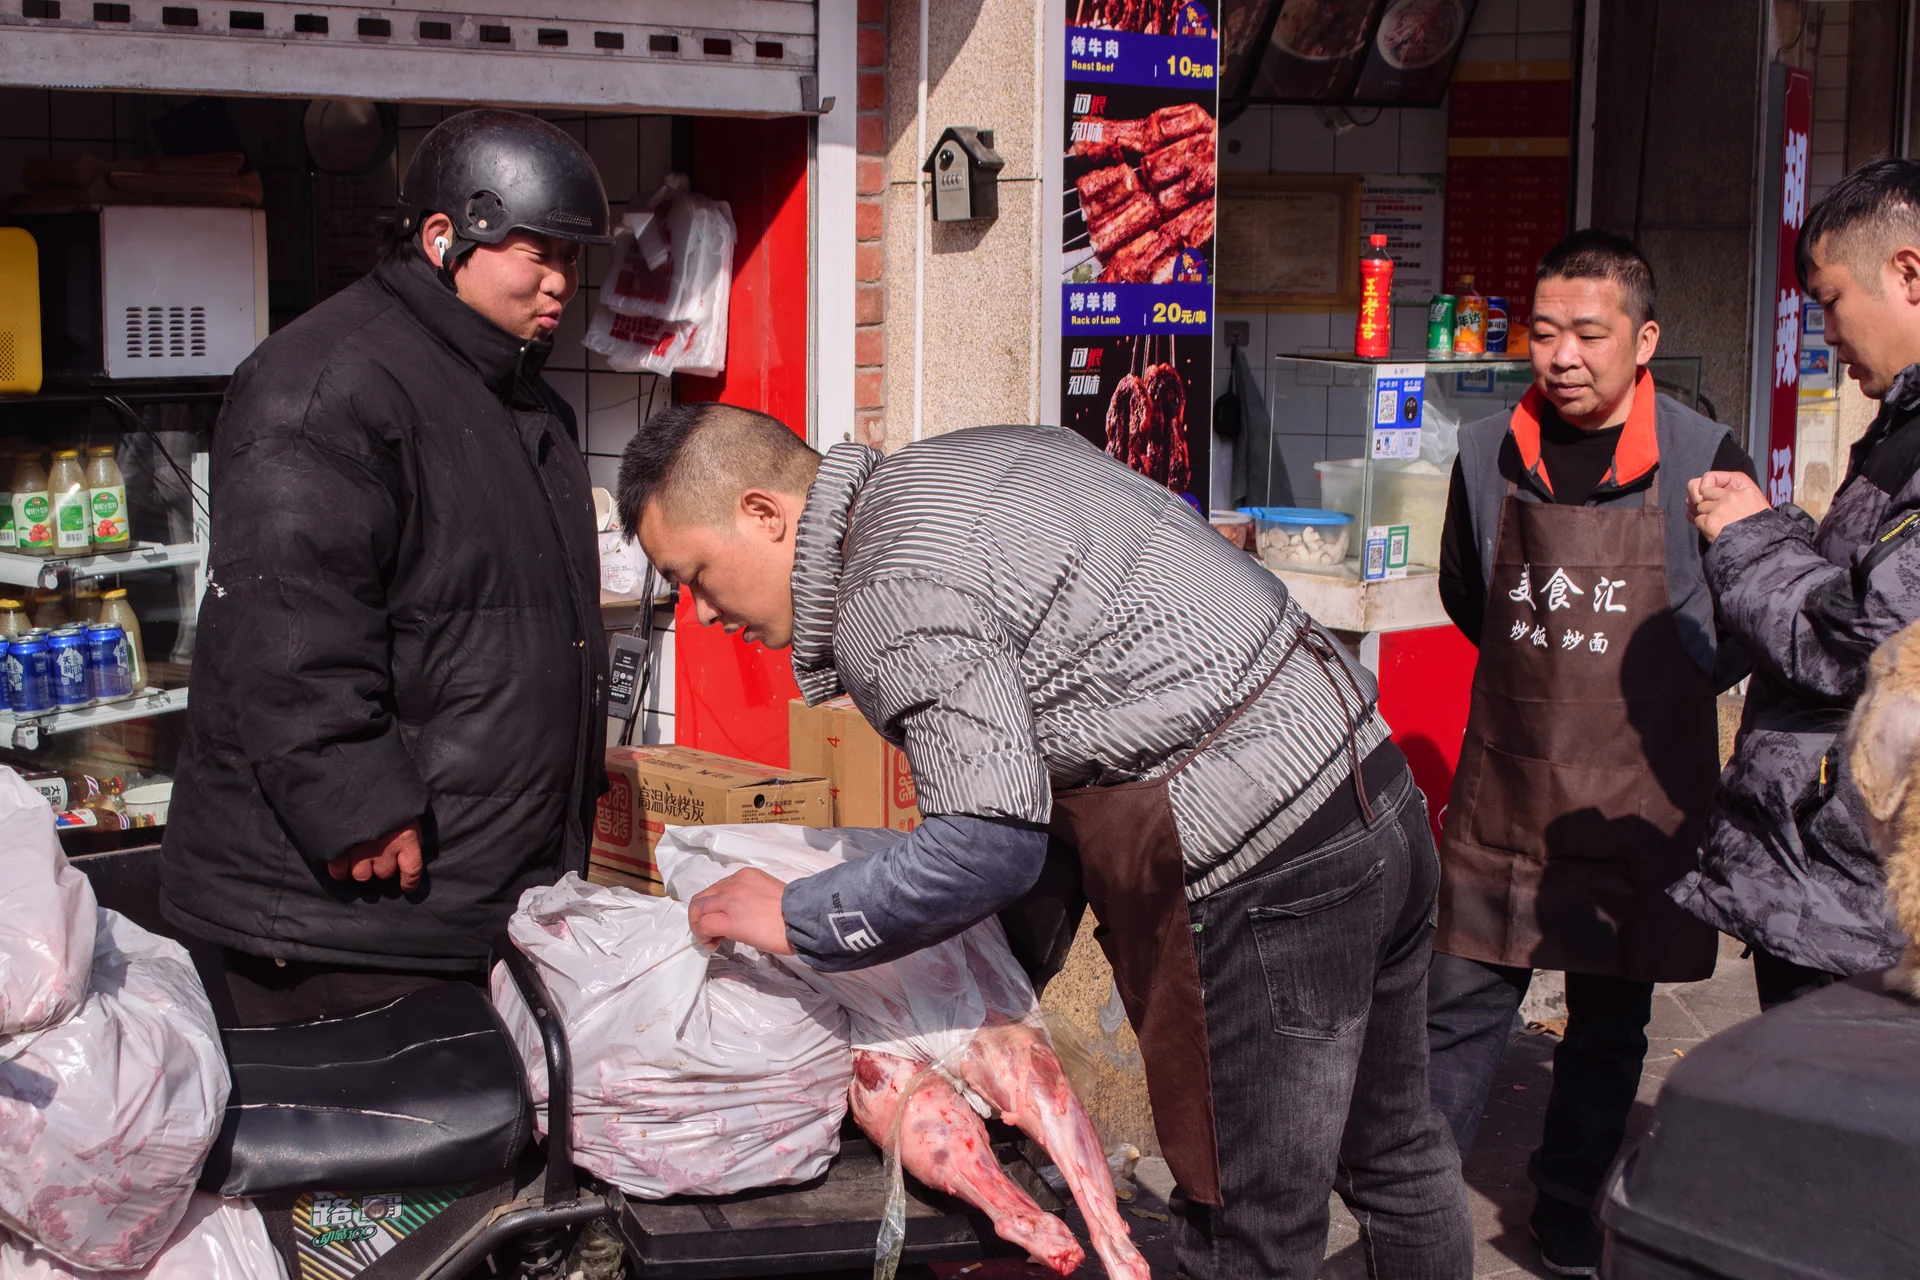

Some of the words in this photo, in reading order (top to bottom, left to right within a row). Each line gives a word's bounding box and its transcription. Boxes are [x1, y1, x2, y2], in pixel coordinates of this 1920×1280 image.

[1071, 36, 1119, 58] 烤牛肉
[1071, 60, 1094, 71] Roast
[1096, 61, 1114, 72] Beef
[1167, 55, 1213, 79] 10元/串
[1070, 292, 1116, 312] 烤羊排
[1152, 303, 1207, 324] 20元/串
[1361, 278, 1379, 339] 王老吉
[1071, 315, 1090, 325] Rack
[1091, 315, 1099, 325] of
[1101, 315, 1120, 325] Lamb
[1508, 563, 1627, 612] 美食汇
[1510, 619, 1548, 648] 炒饭
[1561, 629, 1609, 654] 炒面
[638, 785, 706, 824] 高温烧烤炭
